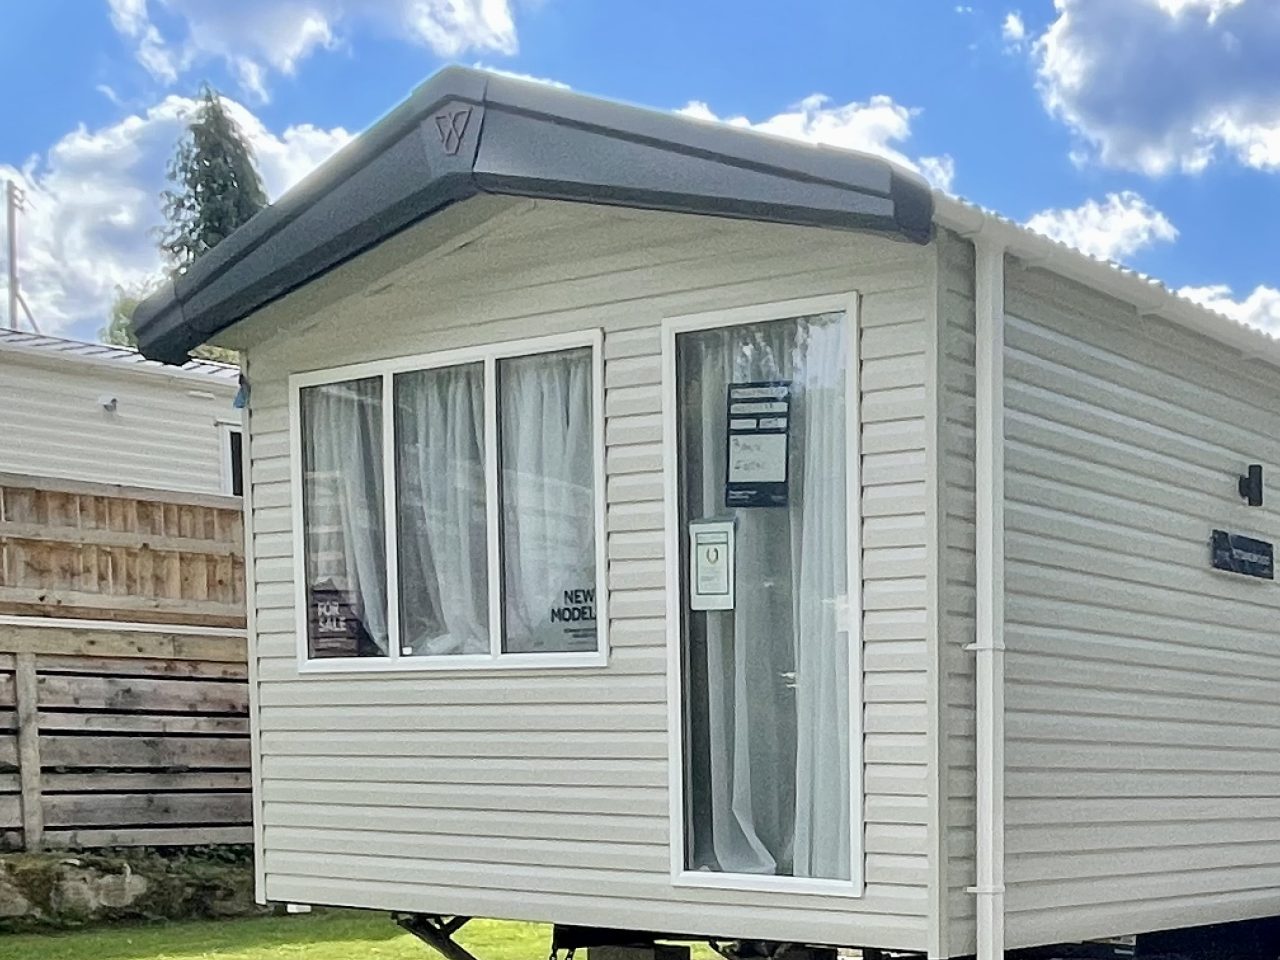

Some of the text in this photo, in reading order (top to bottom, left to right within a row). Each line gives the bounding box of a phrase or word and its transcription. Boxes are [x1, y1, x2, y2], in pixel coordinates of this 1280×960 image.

[564, 589, 595, 604] NEW
[318, 600, 340, 616] FOR
[551, 606, 596, 622] MODEL
[318, 616, 347, 632] SALE
